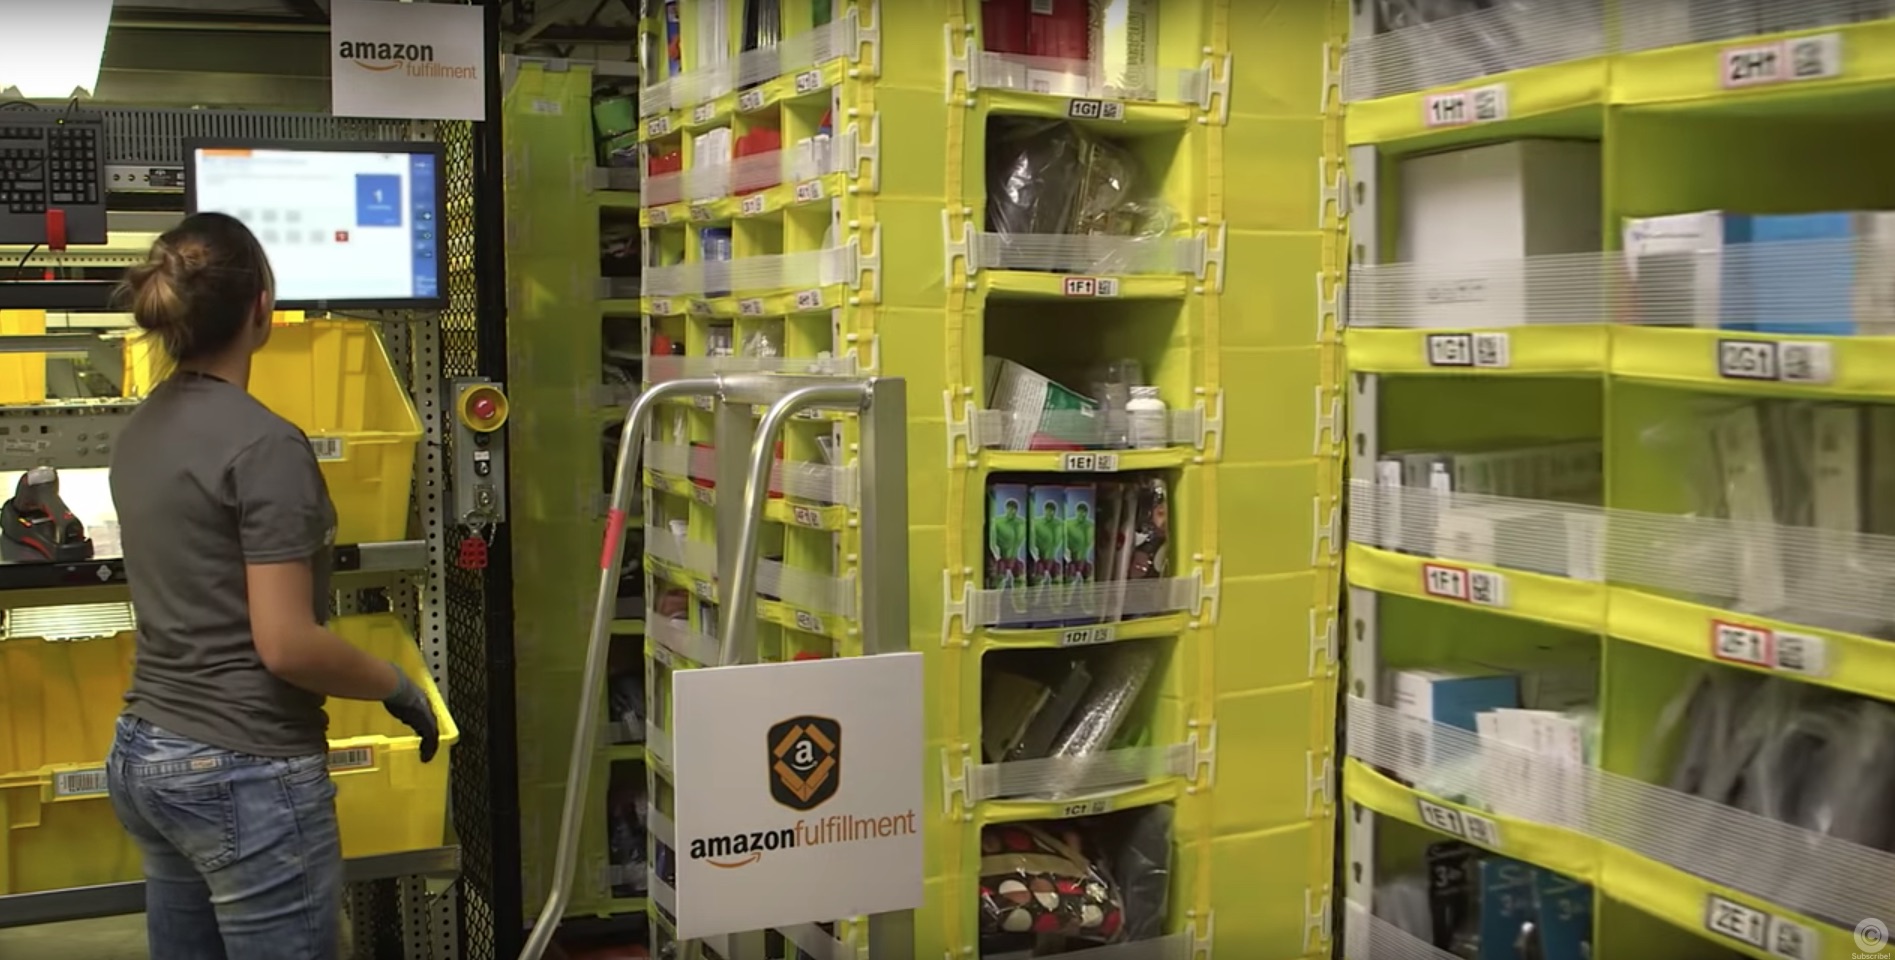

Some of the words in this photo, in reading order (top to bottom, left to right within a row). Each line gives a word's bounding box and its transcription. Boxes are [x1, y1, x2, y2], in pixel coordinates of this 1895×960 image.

[339, 41, 434, 62] amazon
[406, 62, 478, 79] fulfillment
[1075, 103, 1091, 115] 1G
[1070, 281, 1085, 292] 1F
[1070, 457, 1085, 468] 1E
[1066, 633, 1082, 643] 1D
[795, 740, 814, 764] a
